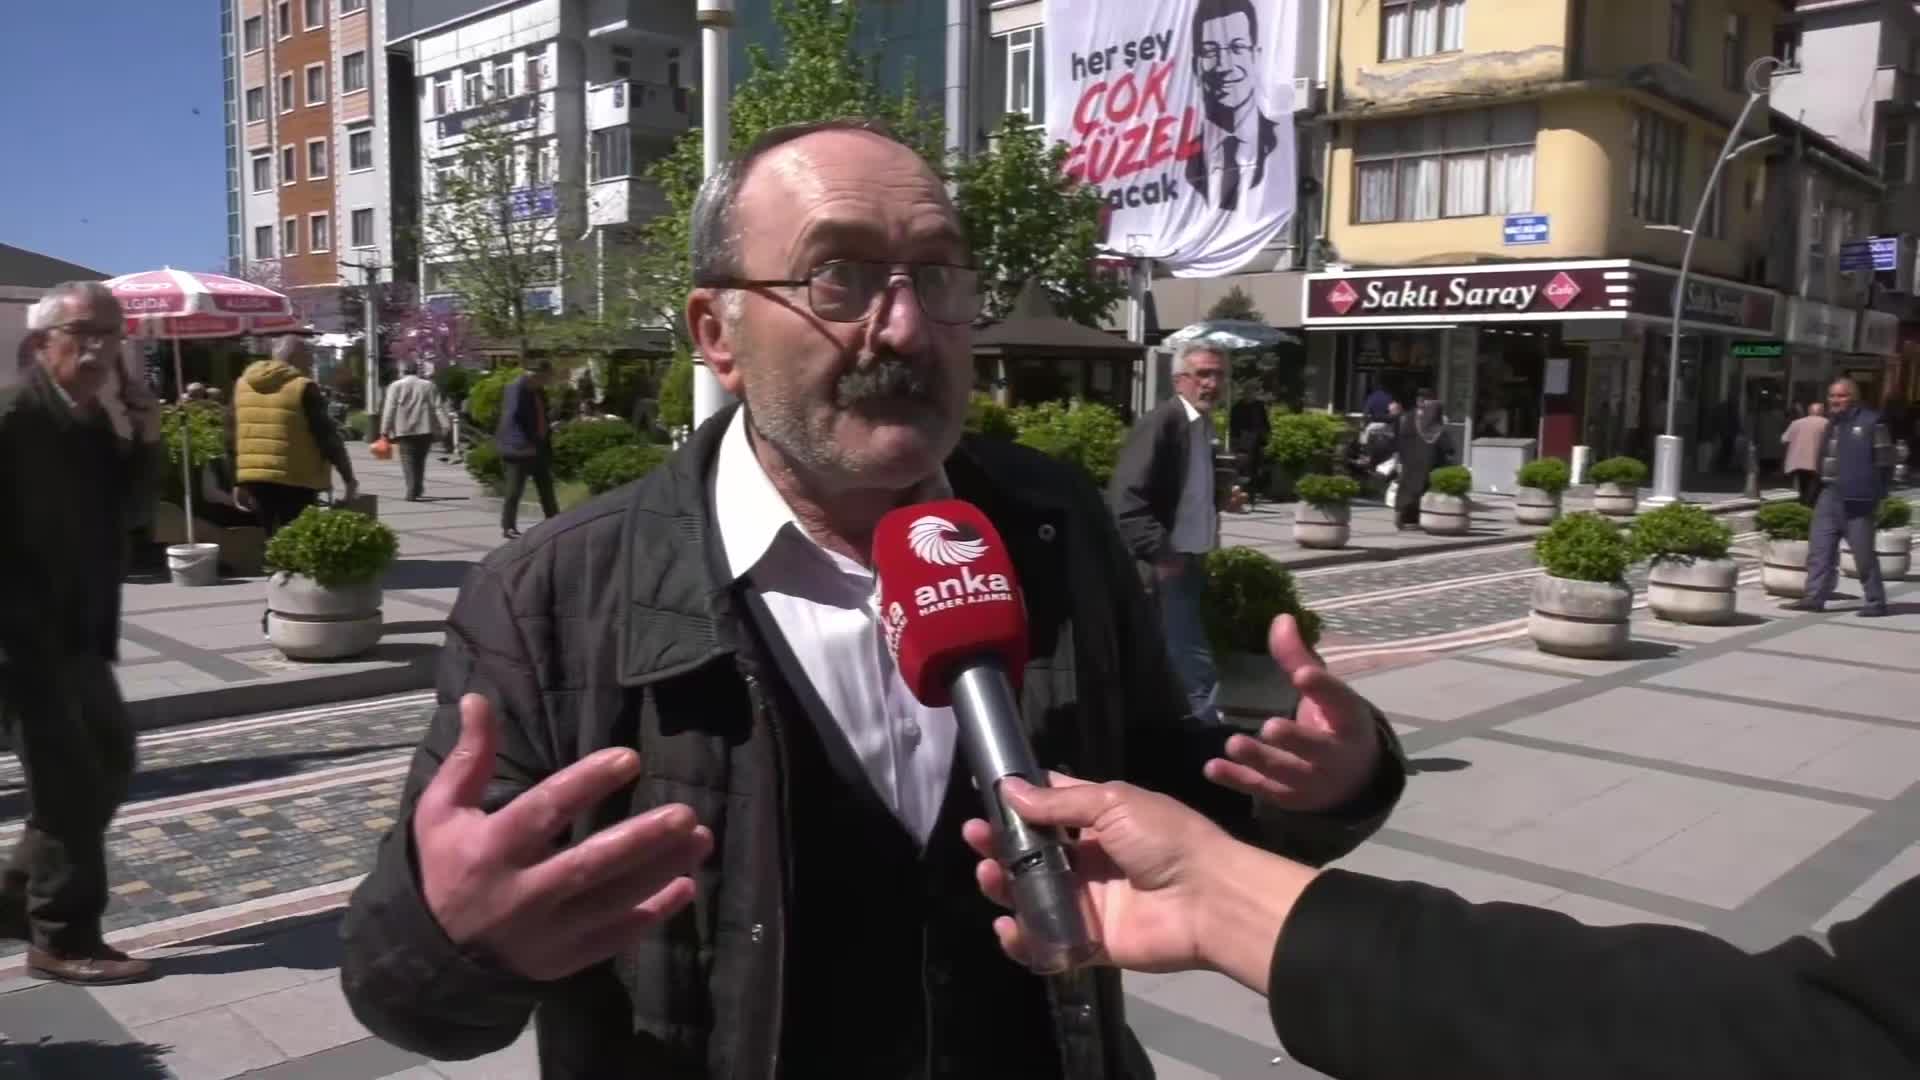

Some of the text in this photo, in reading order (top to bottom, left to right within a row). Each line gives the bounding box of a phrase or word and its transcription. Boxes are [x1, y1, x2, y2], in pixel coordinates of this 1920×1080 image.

[1071, 29, 1173, 81] her şey
[1073, 57, 1175, 140] ÇOK
[1108, 172, 1179, 211] acak
[1361, 280, 1438, 308] Saklı
[1445, 277, 1537, 310] Saray
[914, 565, 1011, 606] anka
[918, 597, 965, 617] HABER
